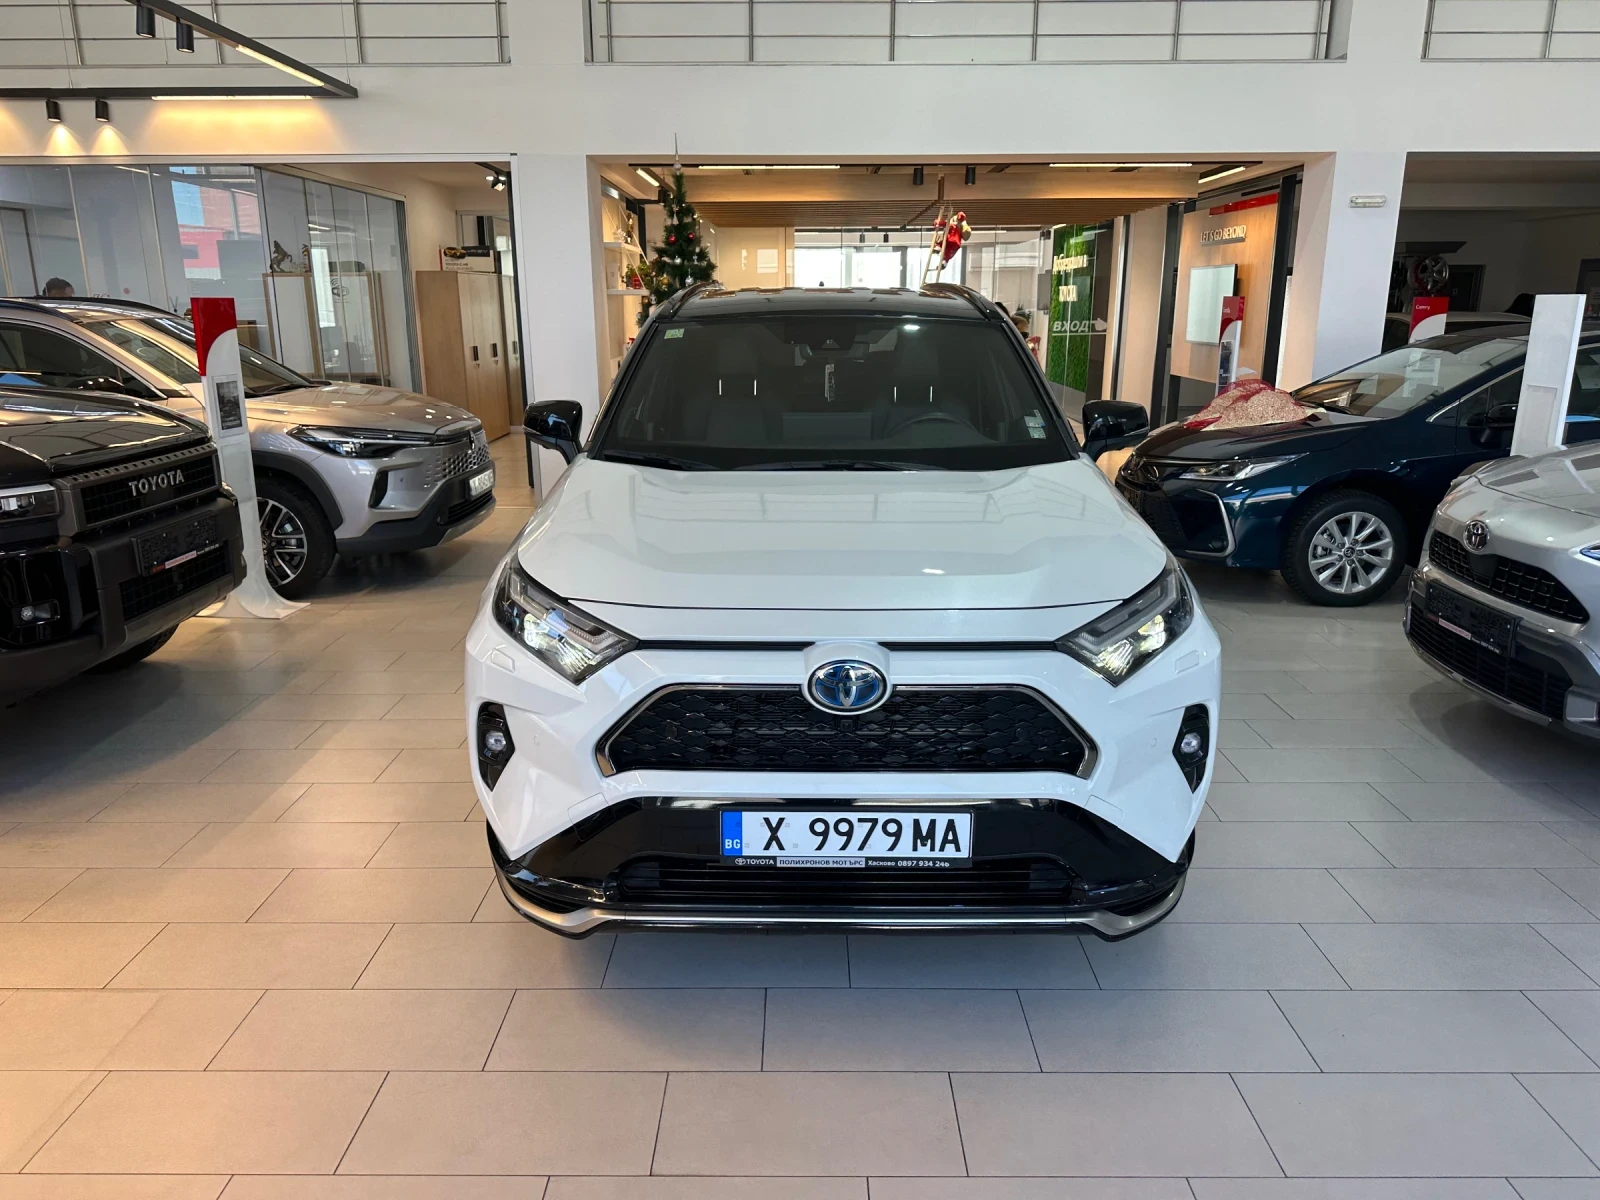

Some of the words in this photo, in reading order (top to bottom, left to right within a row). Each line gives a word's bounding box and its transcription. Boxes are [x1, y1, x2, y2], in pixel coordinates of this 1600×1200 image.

[1223, 225, 1247, 239] BEYOND
[1053, 320, 1088, 333] ВХОД
[128, 469, 185, 497] TOYOTA
[762, 817, 786, 851] X
[808, 817, 903, 852] 9979
[912, 818, 962, 853] MA
[724, 838, 741, 850] BG
[747, 858, 775, 866] TOYOTA
[779, 859, 831, 867] ПОЛИХРОНОВ
